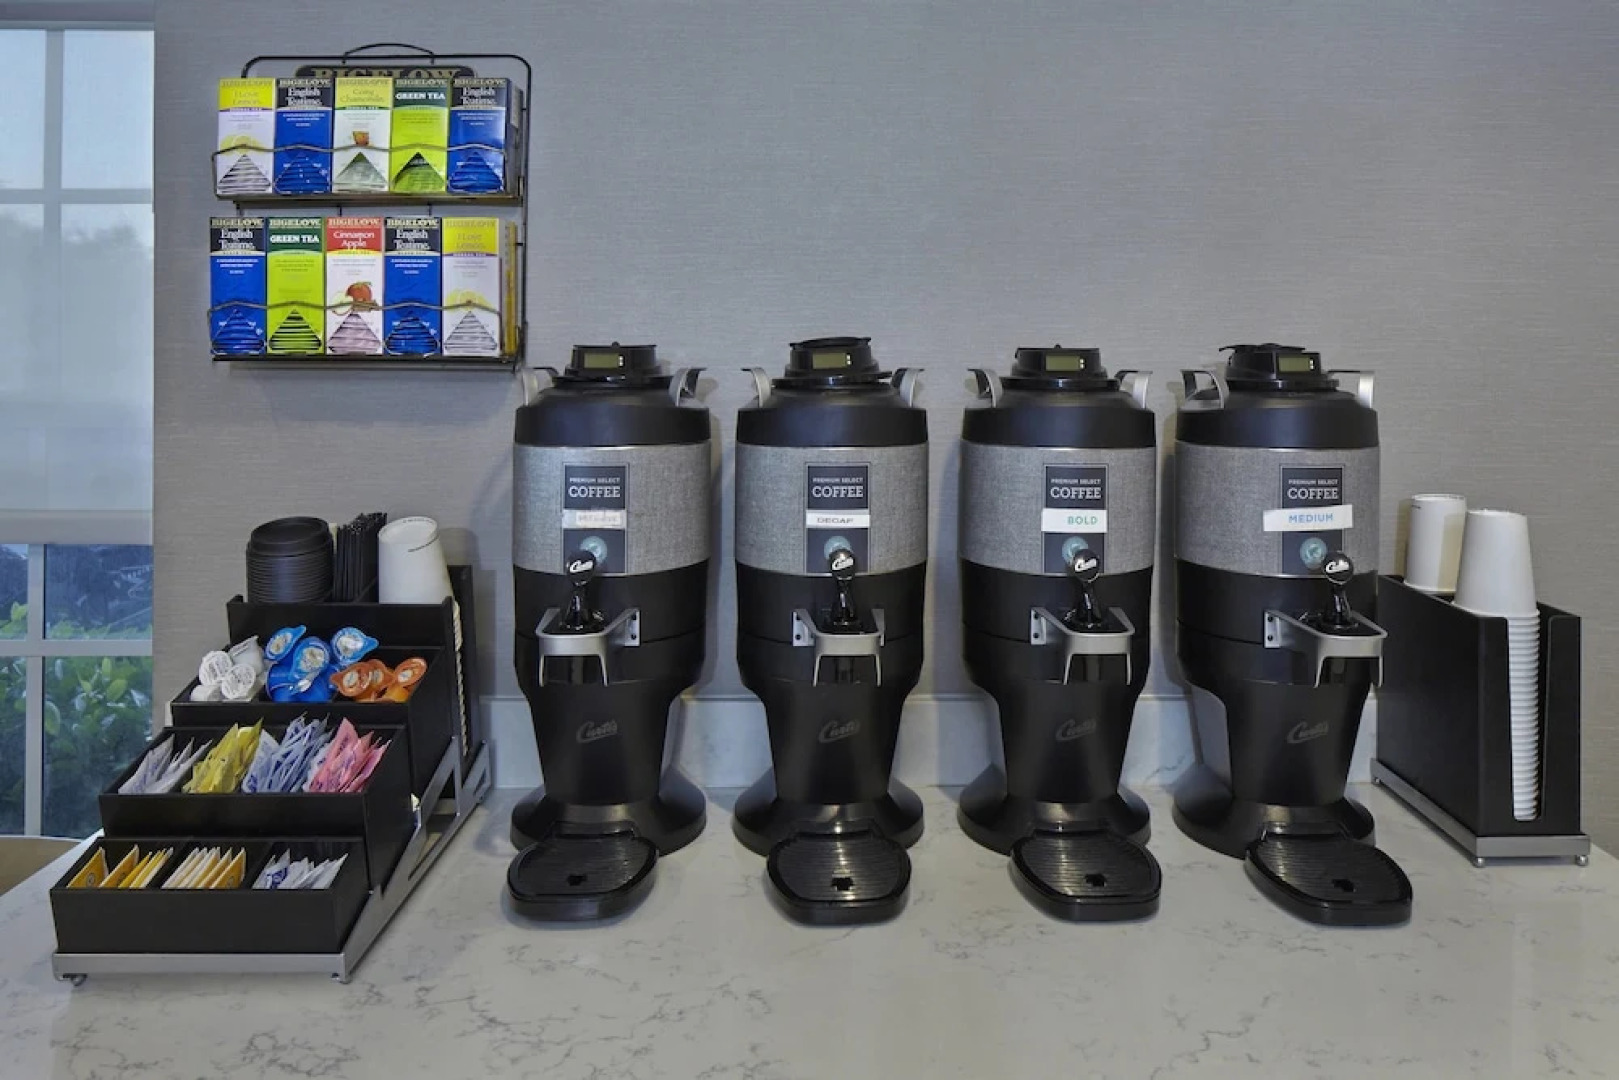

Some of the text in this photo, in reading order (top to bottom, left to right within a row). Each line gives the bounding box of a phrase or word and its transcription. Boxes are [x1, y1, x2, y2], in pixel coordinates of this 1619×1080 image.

[279, 79, 331, 87] BIGELOW
[395, 92, 446, 100] GREEN TEA
[211, 219, 263, 227] BIGELOW
[269, 219, 321, 227] BIGELOW
[328, 219, 380, 227] BIGELOW
[387, 219, 439, 227] BIGELOW
[269, 234, 320, 243] GREEN TEA
[333, 231, 375, 239] Cinnamon
[341, 237, 367, 250] Apple
[568, 486, 621, 498] COFFEE
[812, 485, 864, 498] COFFEE
[1050, 486, 1102, 500] COFFEE
[1287, 487, 1339, 500] COFFEE
[1067, 515, 1098, 525] BOLD
[1288, 513, 1334, 524] MEDIUM
